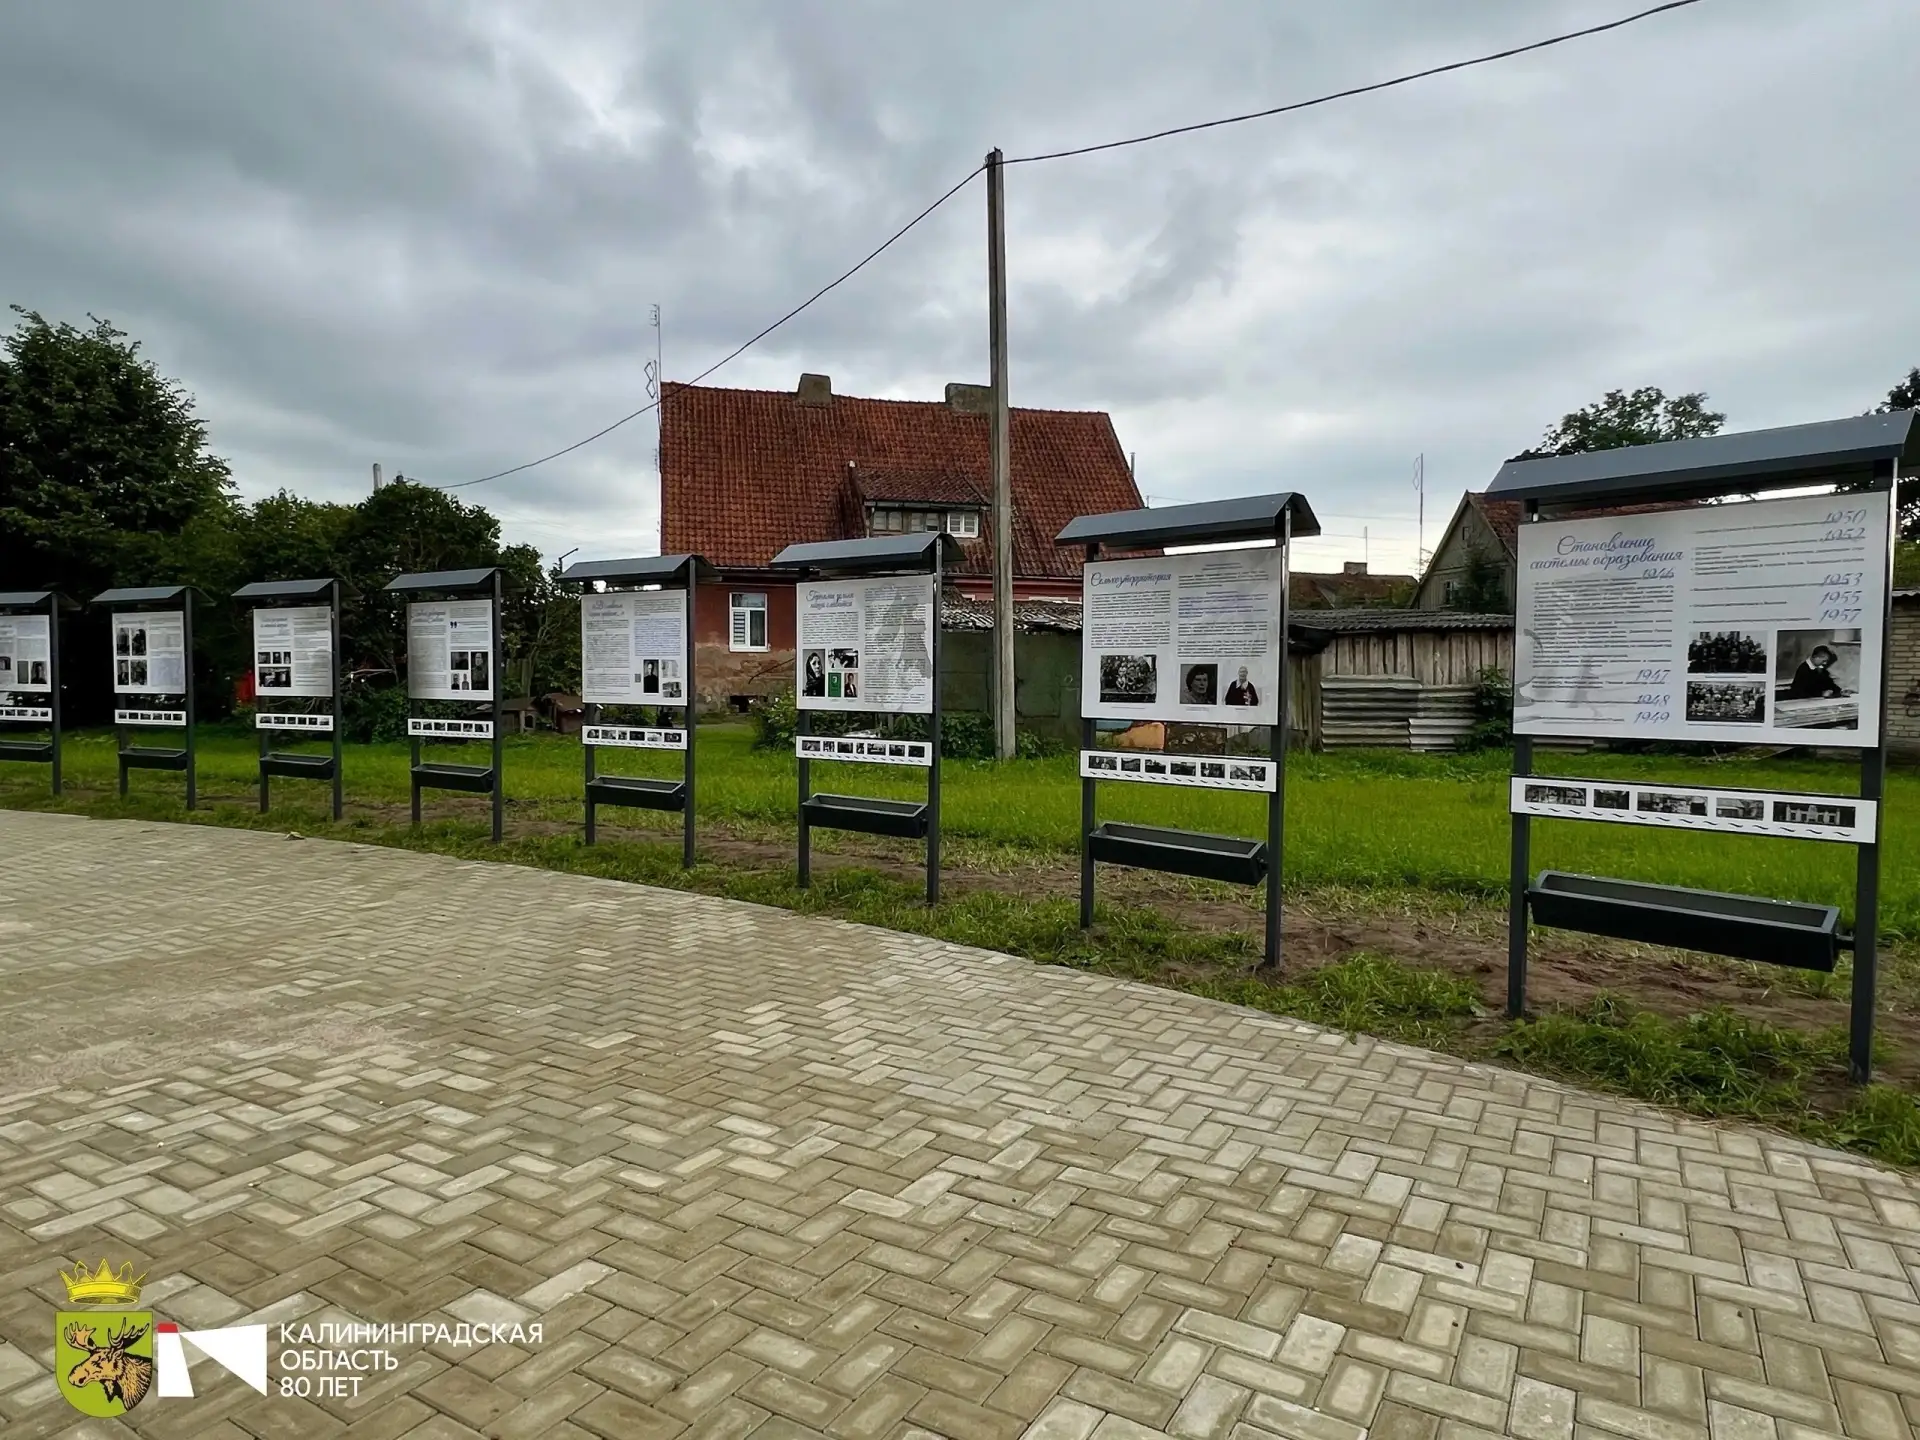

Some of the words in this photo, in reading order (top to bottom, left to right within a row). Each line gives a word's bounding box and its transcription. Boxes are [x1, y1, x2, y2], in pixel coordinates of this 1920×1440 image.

[1824, 509, 1867, 524] 1950
[1821, 528, 1866, 541] 1952
[1530, 557, 1590, 570] системы
[1593, 545, 1684, 571] образования
[1822, 572, 1863, 586] 1953
[1820, 591, 1862, 605] 1955
[1819, 608, 1862, 623] 1957
[1635, 669, 1671, 681] 1947
[1637, 694, 1671, 708] 1948
[1634, 711, 1670, 724] 1949
